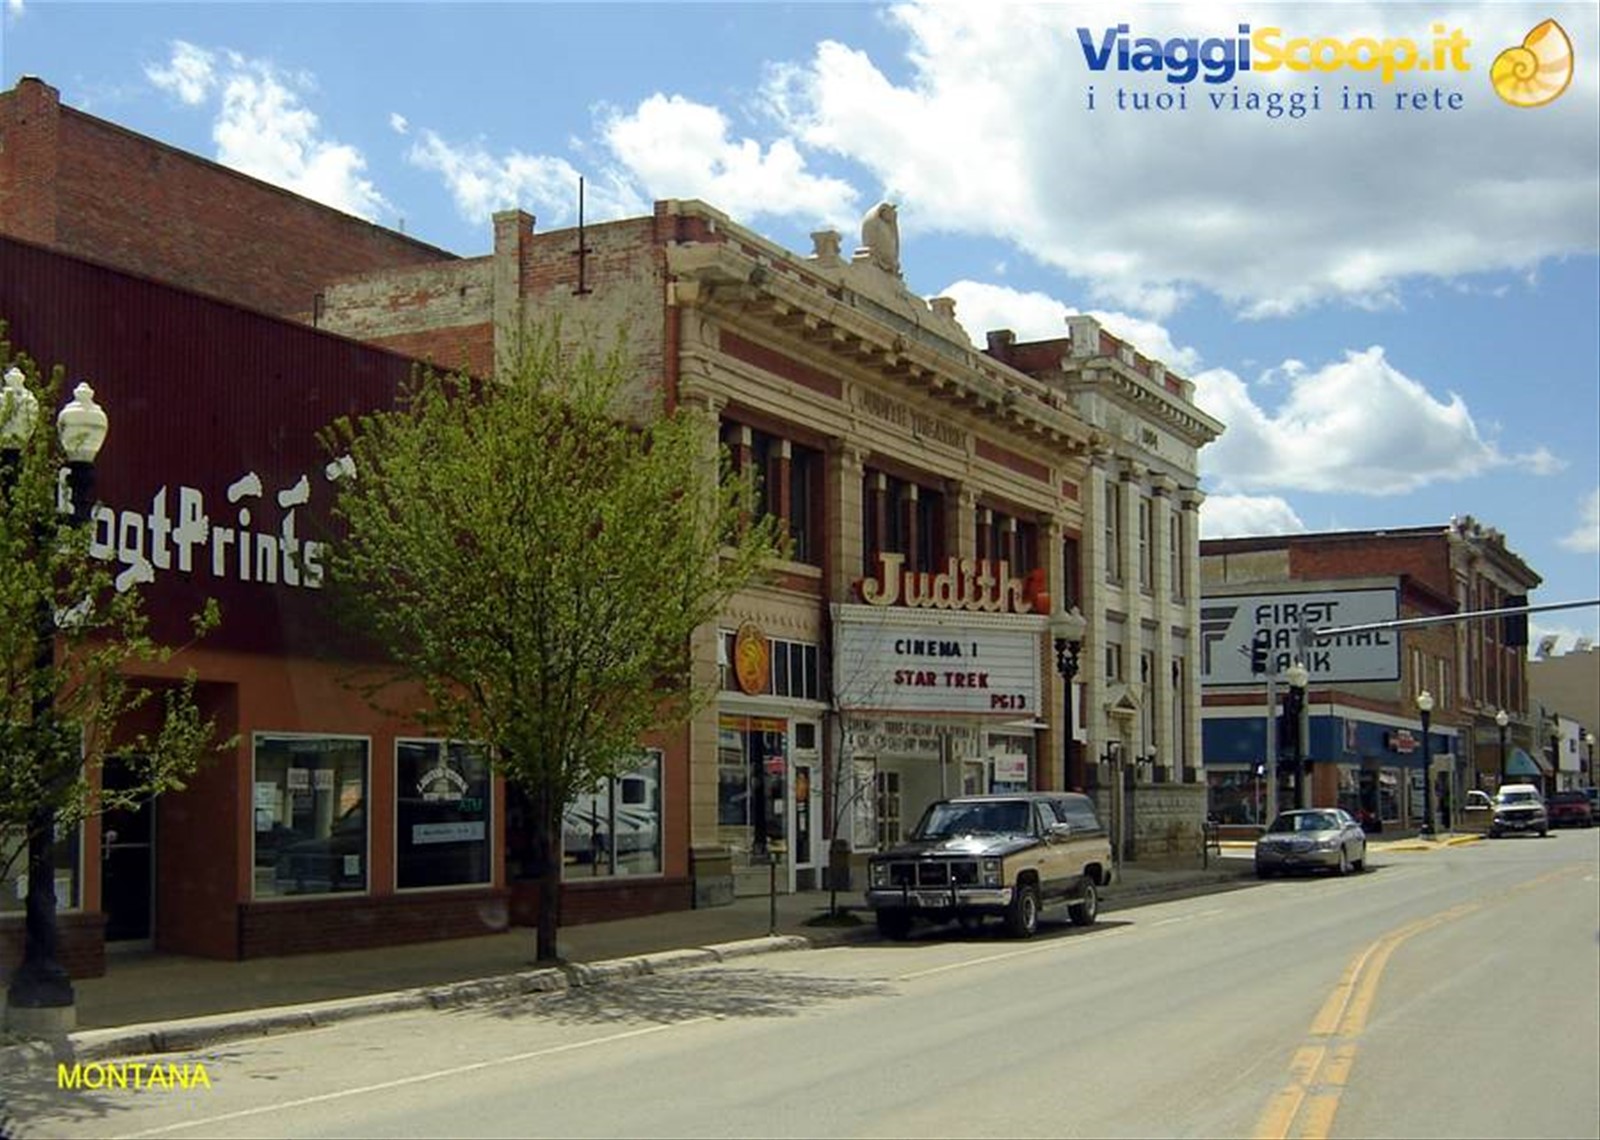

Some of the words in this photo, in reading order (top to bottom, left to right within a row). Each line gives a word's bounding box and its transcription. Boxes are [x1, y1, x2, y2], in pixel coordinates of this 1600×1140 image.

[862, 552, 1032, 613] Judith
[1256, 602, 1339, 624] FIRST
[895, 640, 962, 658] CINEMA
[1255, 652, 1331, 673] AK
[894, 670, 937, 688] STAR
[944, 672, 989, 689] TREK
